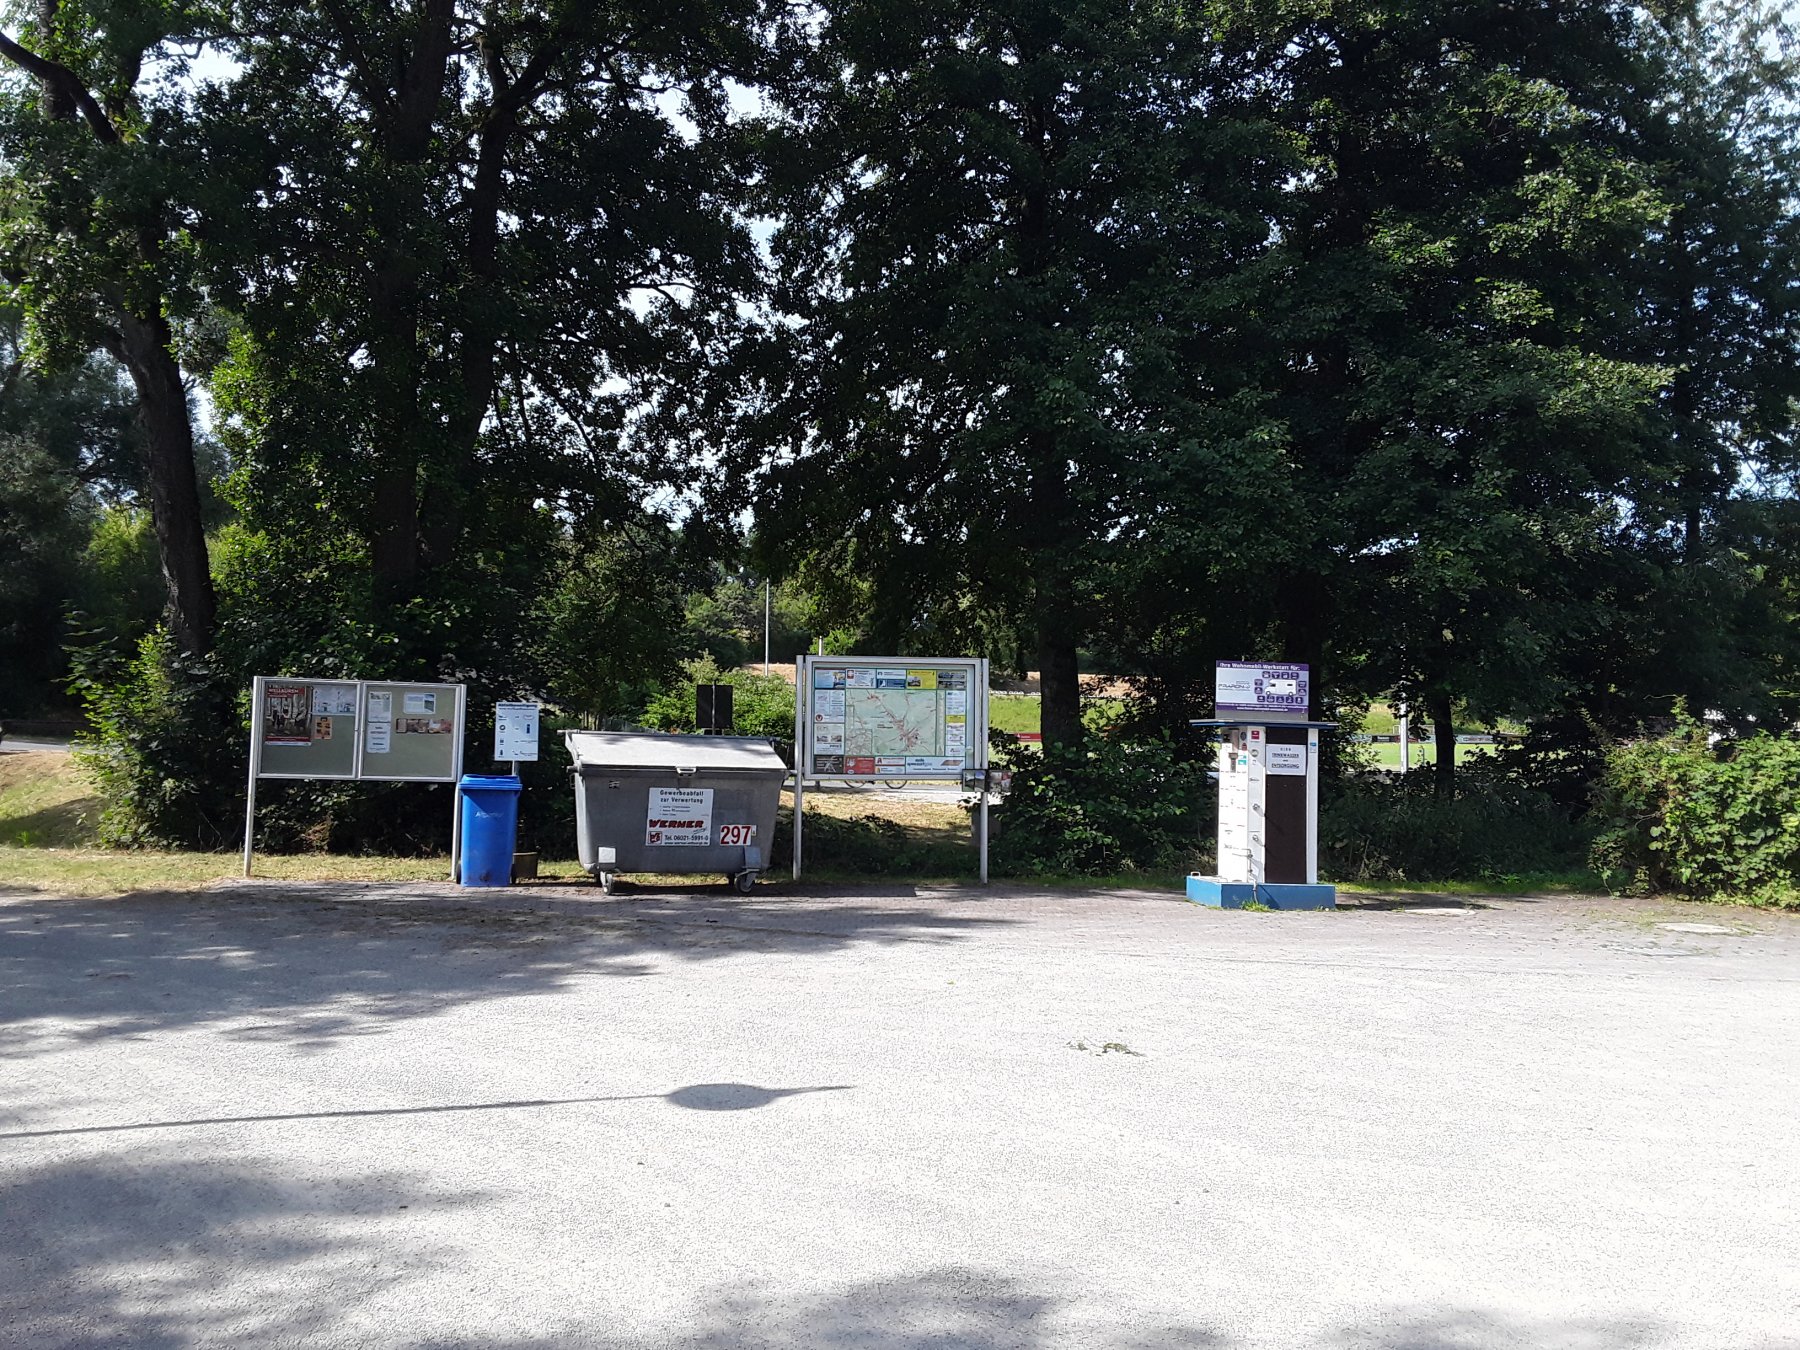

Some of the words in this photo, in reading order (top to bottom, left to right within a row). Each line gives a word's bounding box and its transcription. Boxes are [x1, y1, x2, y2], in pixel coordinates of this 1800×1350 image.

[671, 796, 704, 804] Verwertung
[649, 819, 704, 828] WERNER
[720, 826, 751, 844] 297
